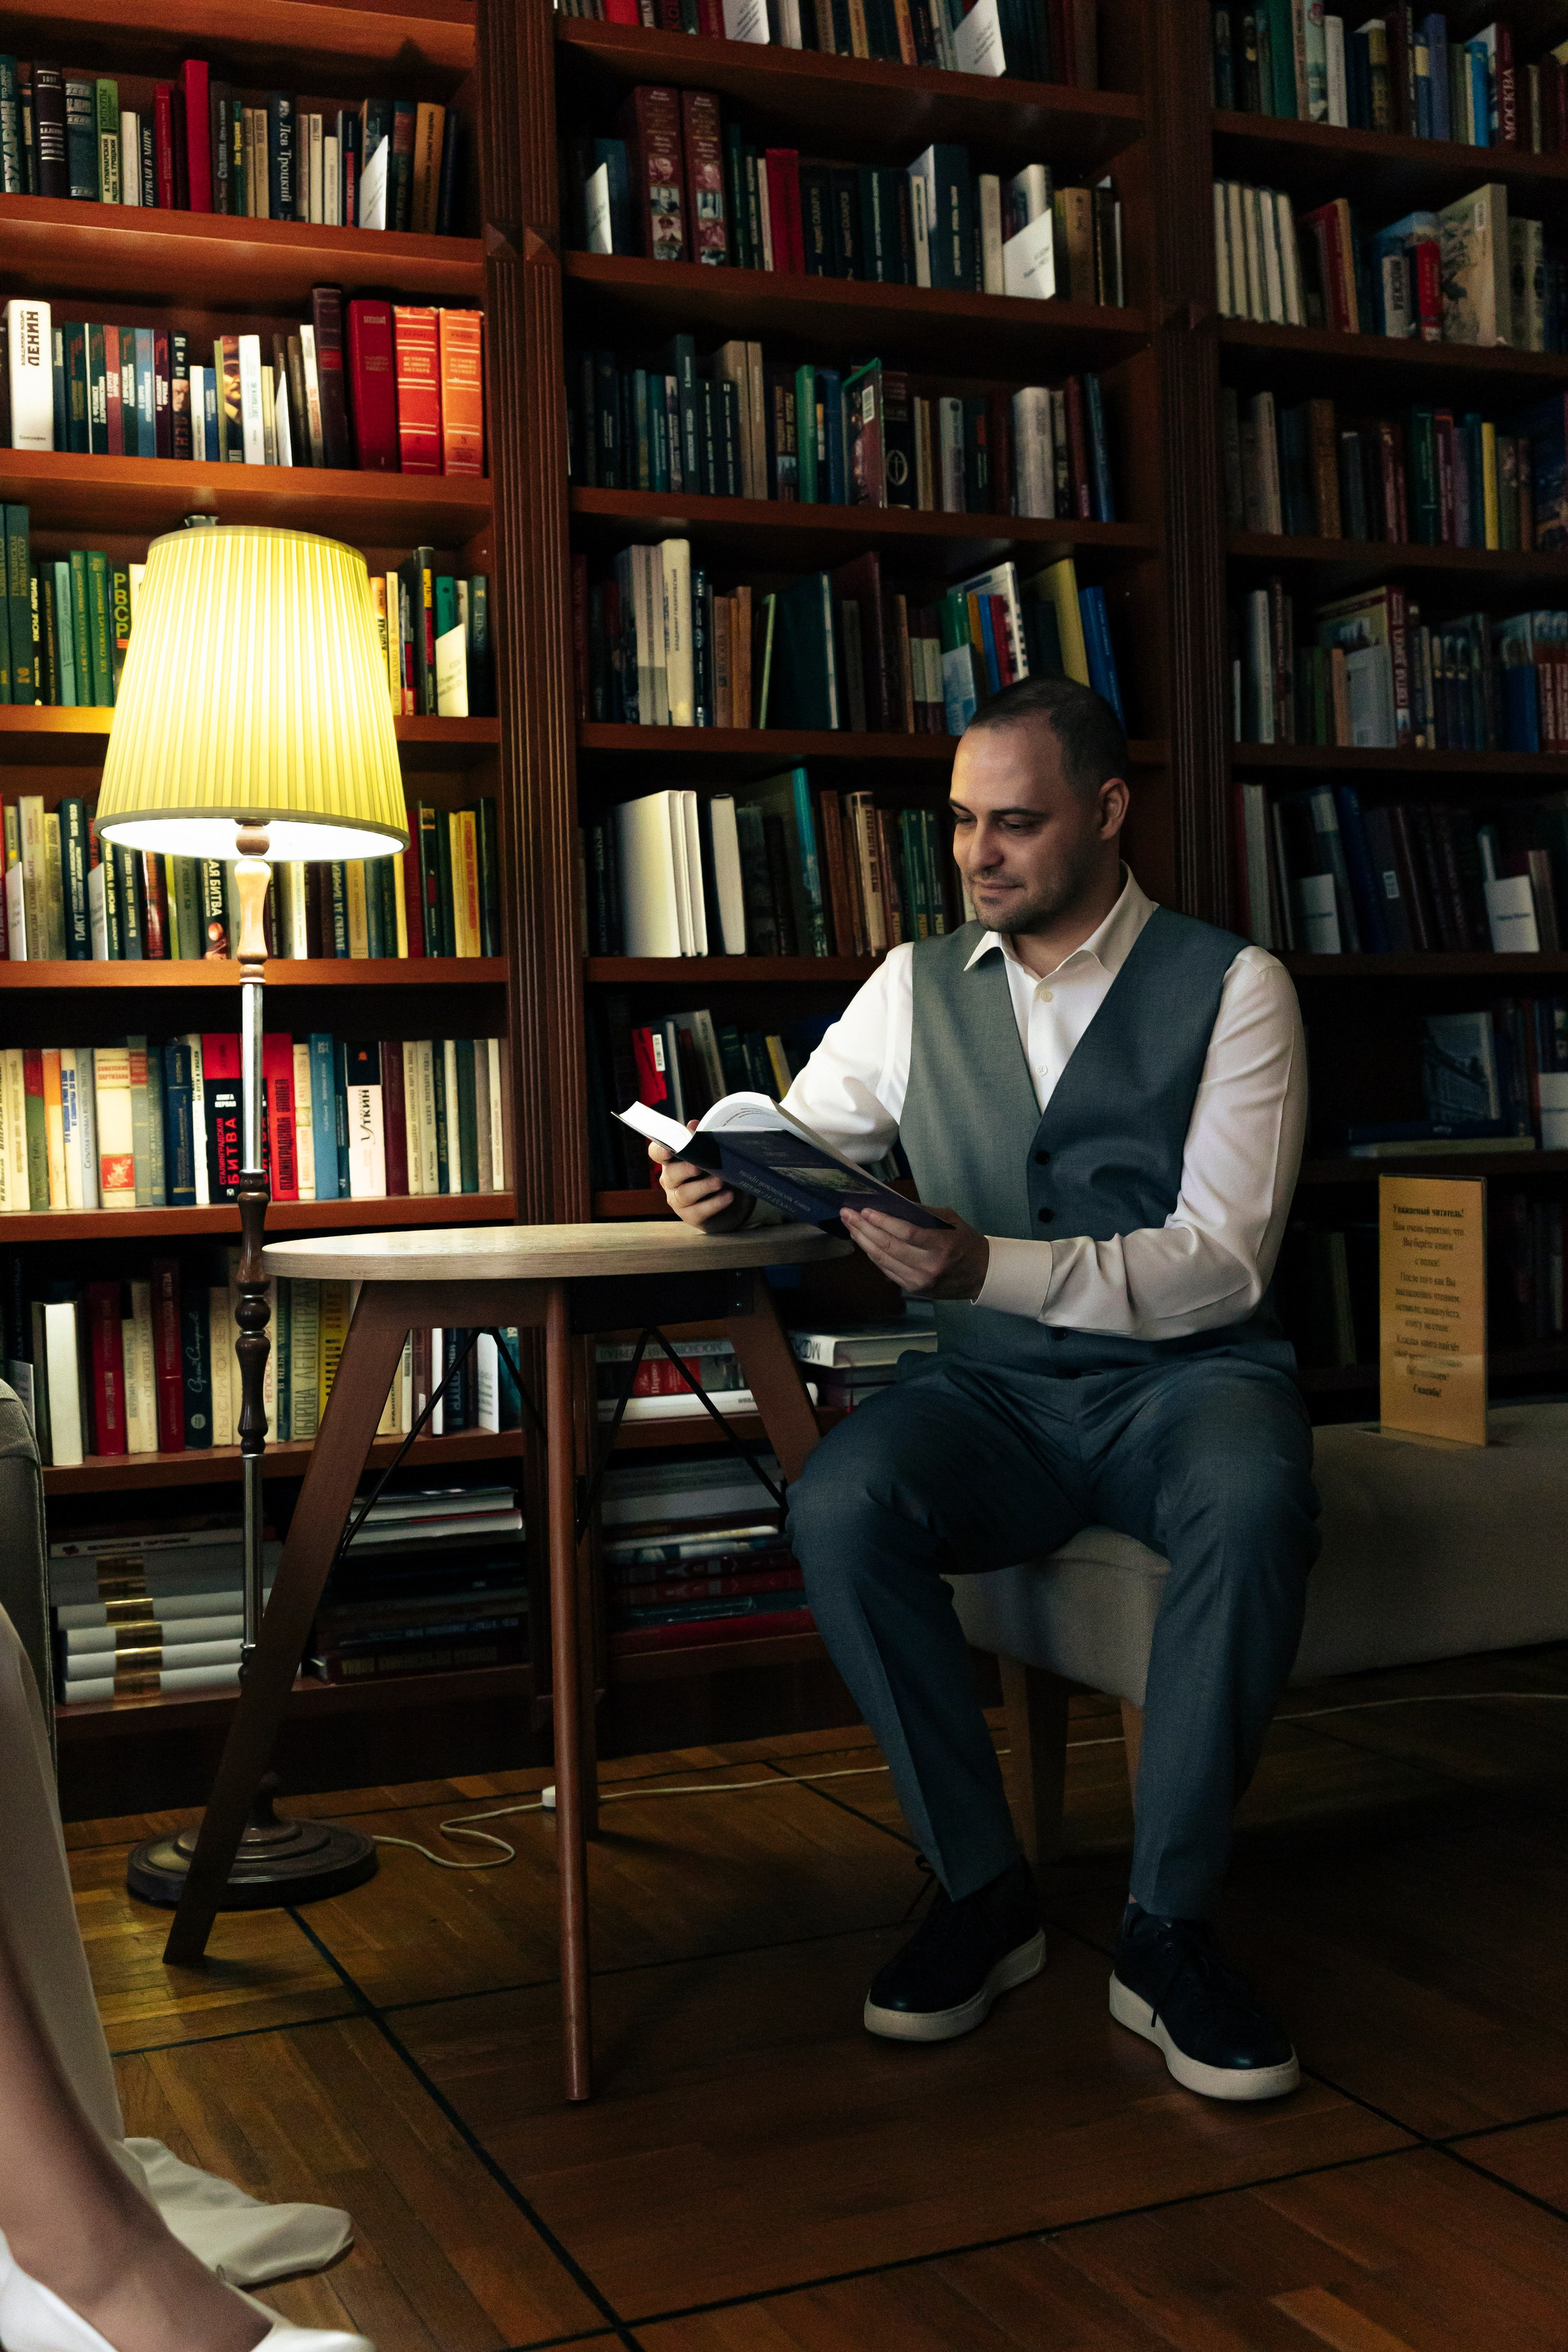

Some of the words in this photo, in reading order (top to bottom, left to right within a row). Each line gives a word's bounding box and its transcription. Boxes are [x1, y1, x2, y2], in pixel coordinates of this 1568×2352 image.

[1502, 67, 1517, 141] МОСКВА
[1, 100, 20, 193] БУХАРИН
[279, 121, 292, 146] Лев
[277, 149, 292, 203] Троцкий
[26, 311, 40, 366] ЛЕНИН
[10, 536, 20, 596] ГРАЖДАНСКАЯ
[18, 536, 26, 562] СССР
[19, 568, 28, 596] ВОЙНА
[106, 862, 115, 881] ТЫЛУ
[107, 889, 116, 915] ФРОНТ
[209, 879, 222, 917] БИТВА
[74, 913, 86, 941] ПАКТ
[275, 1079, 290, 1113] ЭПОПЕЯ
[216, 1117, 227, 1186] СТАЛИНГРАДСКАЯ
[225, 1117, 241, 1186] БИТВА
[276, 1117, 294, 1191] СТАЛИНГРАДСКАЯ
[1392, 1204, 1430, 1216] Уважаемый
[1431, 1207, 1464, 1218] читатель!
[142, 1385, 152, 1398] ОТ
[1412, 1384, 1442, 1398] Спасибо!
[293, 1388, 317, 1436] ОБОРОНА
